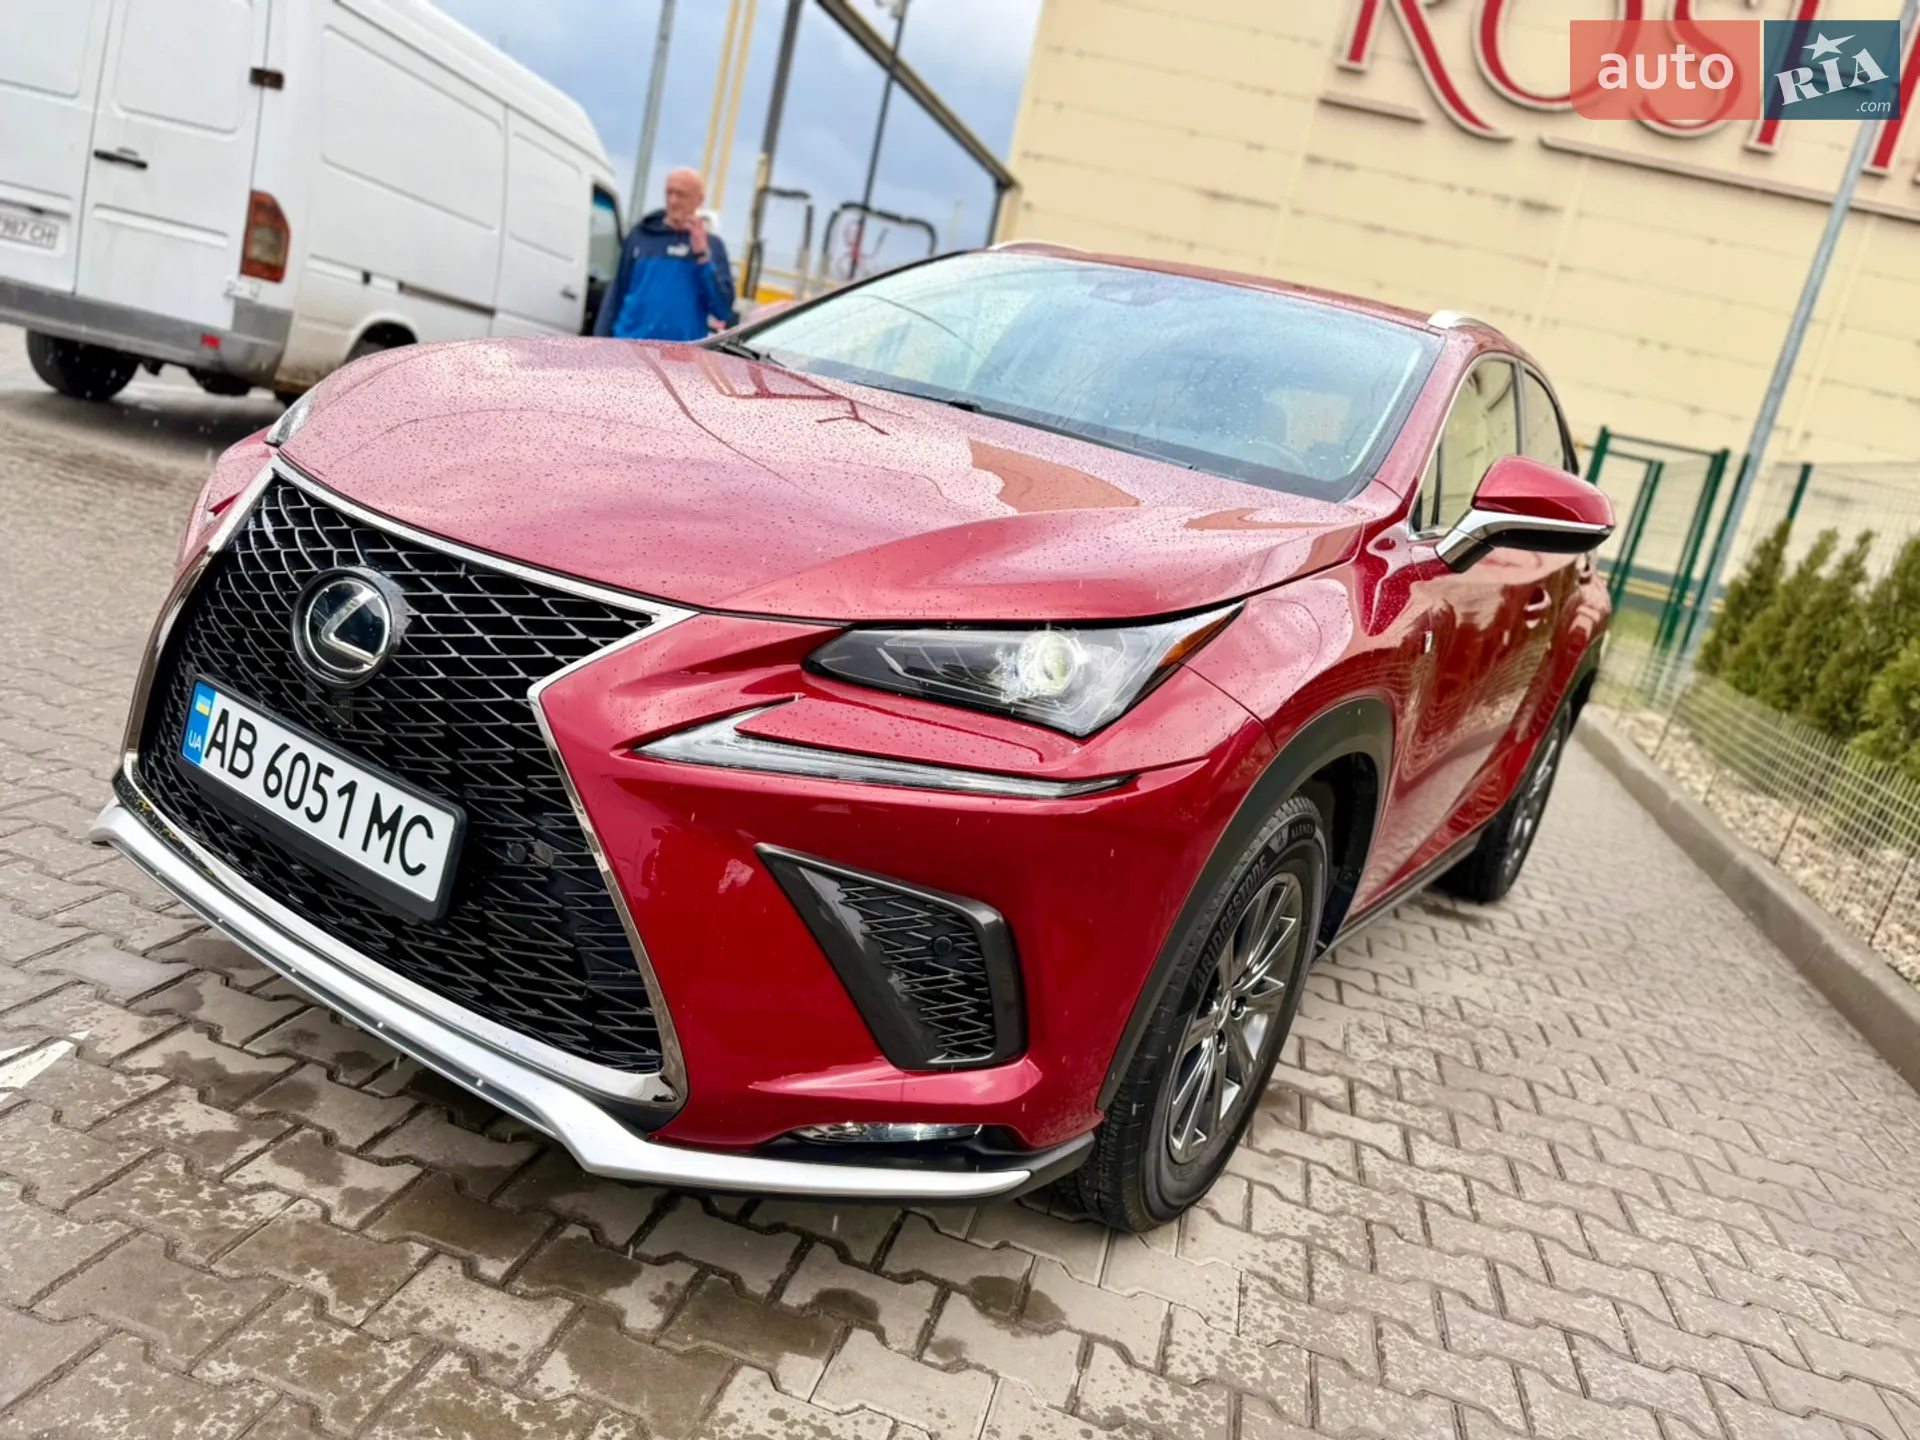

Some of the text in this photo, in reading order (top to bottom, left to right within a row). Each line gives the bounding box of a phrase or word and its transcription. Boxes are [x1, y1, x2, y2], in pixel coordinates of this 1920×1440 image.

[188, 734, 202, 751] UA
[204, 708, 434, 876] AB 6051 MC
[1190, 854, 1267, 991] BRIDGESTONE
